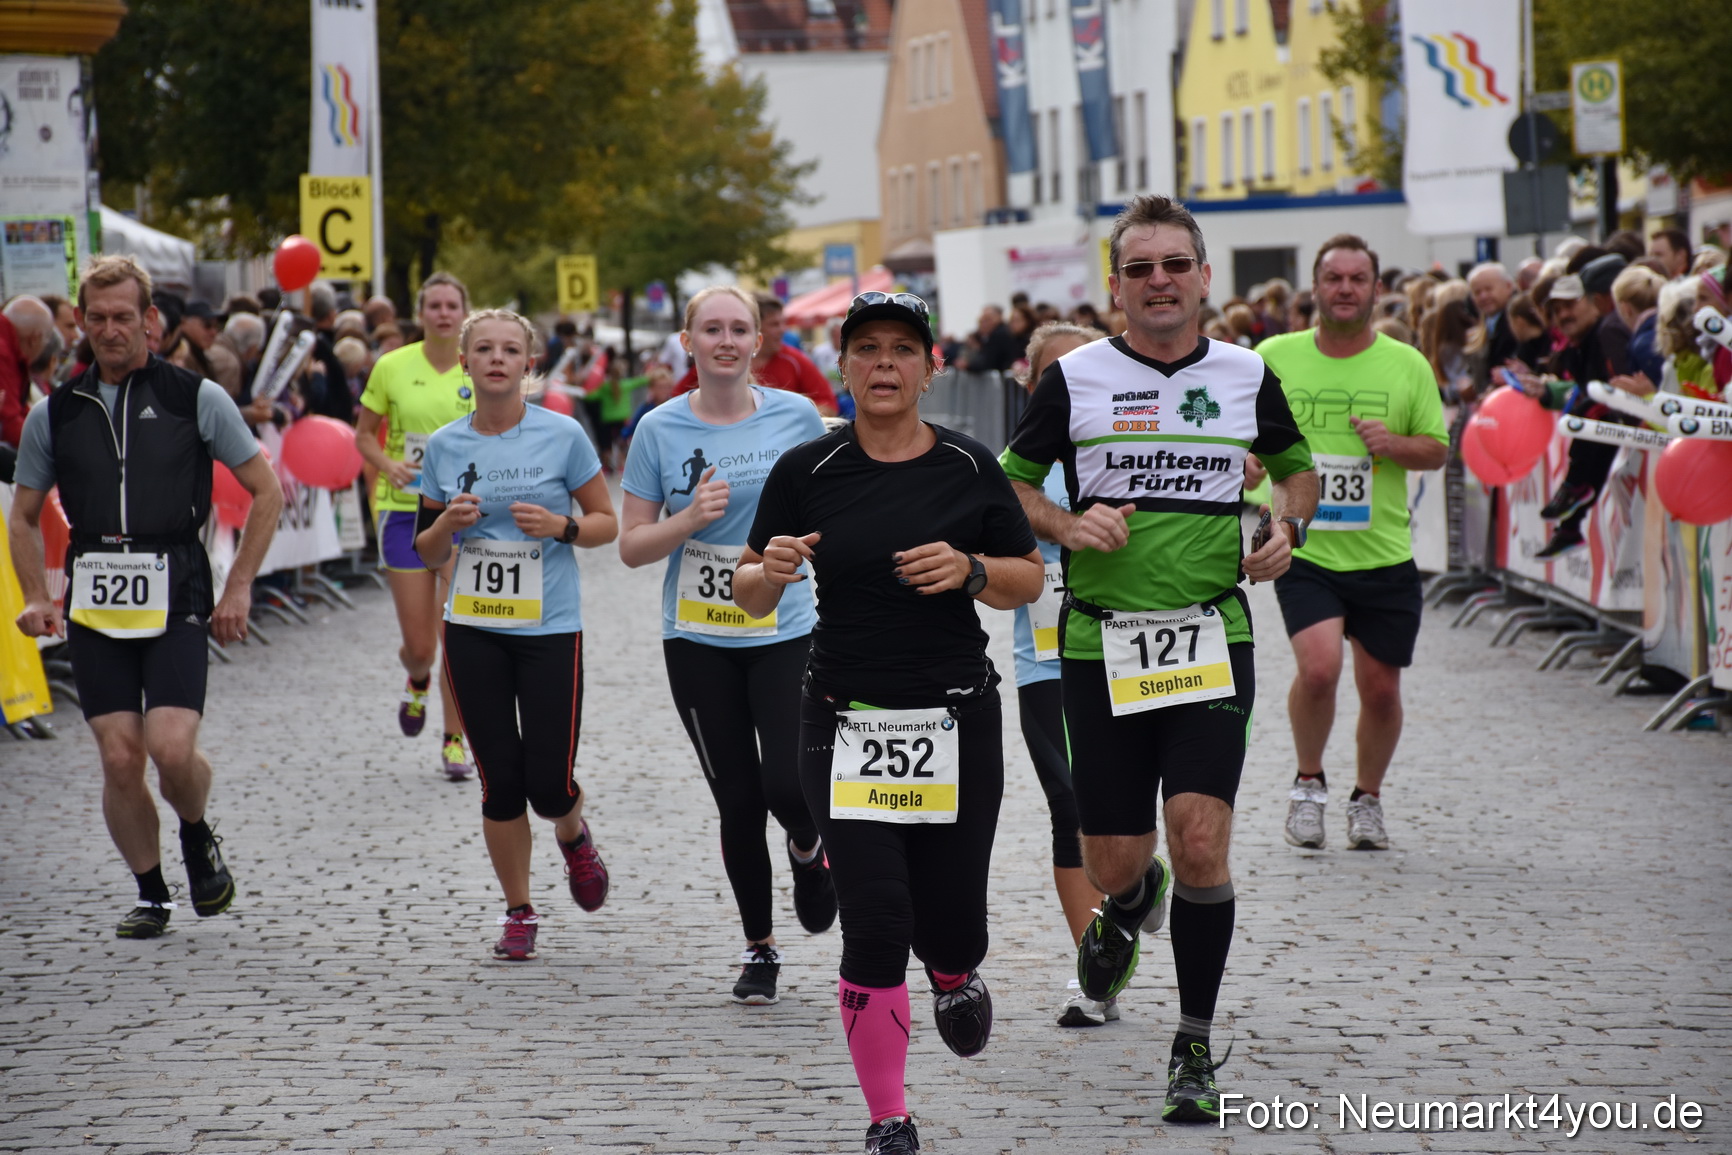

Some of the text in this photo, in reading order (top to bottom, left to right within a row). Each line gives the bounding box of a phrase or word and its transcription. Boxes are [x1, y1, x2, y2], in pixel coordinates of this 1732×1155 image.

[309, 179, 362, 199] Block
[319, 207, 352, 256] C
[568, 273, 588, 300] D
[1137, 390, 1159, 400] RACER
[1112, 420, 1160, 432] OBI
[719, 449, 779, 469] GYM HIP
[1105, 450, 1232, 472] Laufteam
[487, 466, 544, 482] GYM HIP
[1128, 474, 1203, 493] Fürth
[1315, 507, 1342, 522] Sepp
[463, 546, 526, 559] PARTL Neumarkt
[684, 547, 739, 564] PARTL Neum
[76, 561, 151, 571] PARTL Neumarkt
[472, 560, 520, 595] 191
[698, 565, 734, 602] 33
[91, 574, 149, 606] 520
[472, 601, 515, 616] Sandra
[706, 608, 745, 624] Katrin
[1105, 620, 1142, 630] PARTL
[1130, 624, 1201, 670] 127
[1139, 674, 1203, 696] Stephan
[1222, 703, 1245, 715] asics
[841, 720, 937, 732] PARTL Neumarkt
[859, 737, 935, 778] 252
[868, 788, 923, 810] Angela
